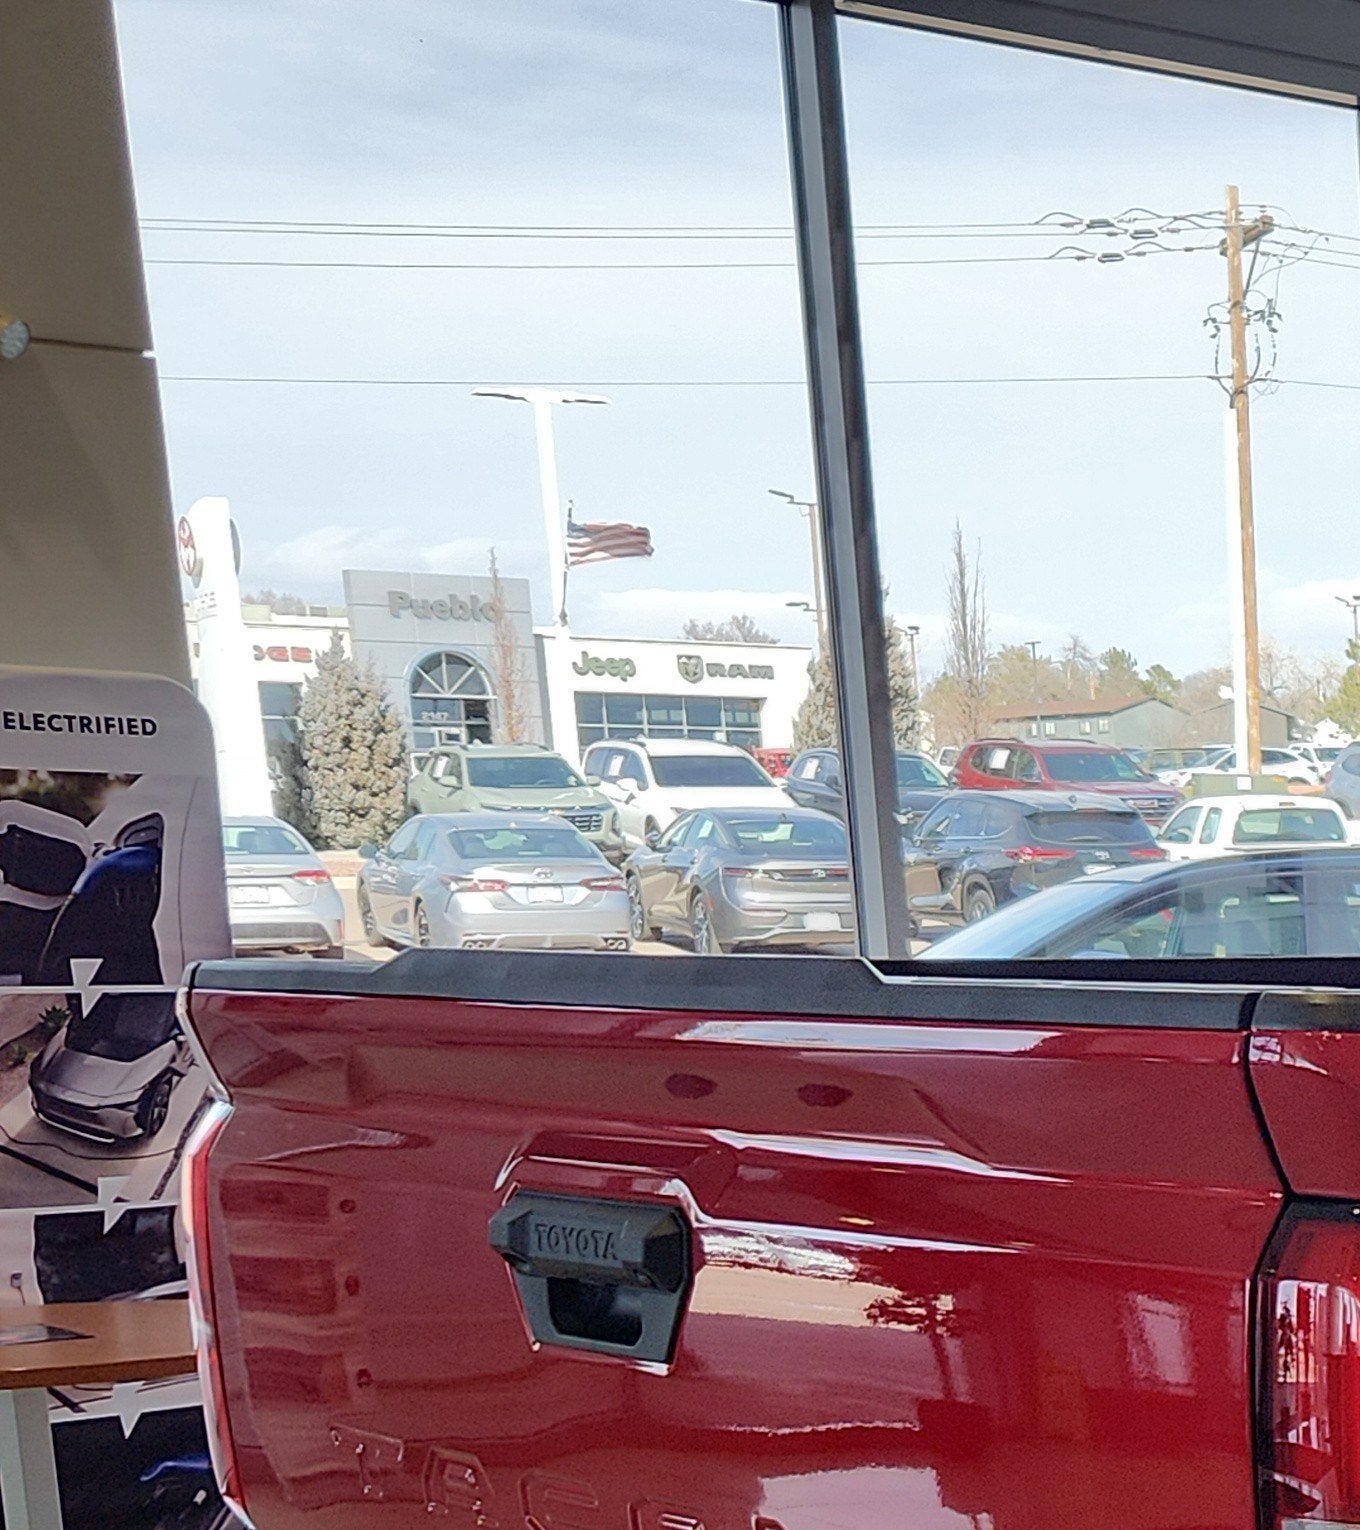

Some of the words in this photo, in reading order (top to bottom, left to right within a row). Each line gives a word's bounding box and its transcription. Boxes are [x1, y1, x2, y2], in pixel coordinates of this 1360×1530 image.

[386, 590, 499, 623] Pueblo
[571, 650, 637, 682] Jeep
[705, 662, 775, 680] RAM
[2, 711, 158, 737] ELECTRIFIED
[533, 1222, 619, 1262] TOYOTA
